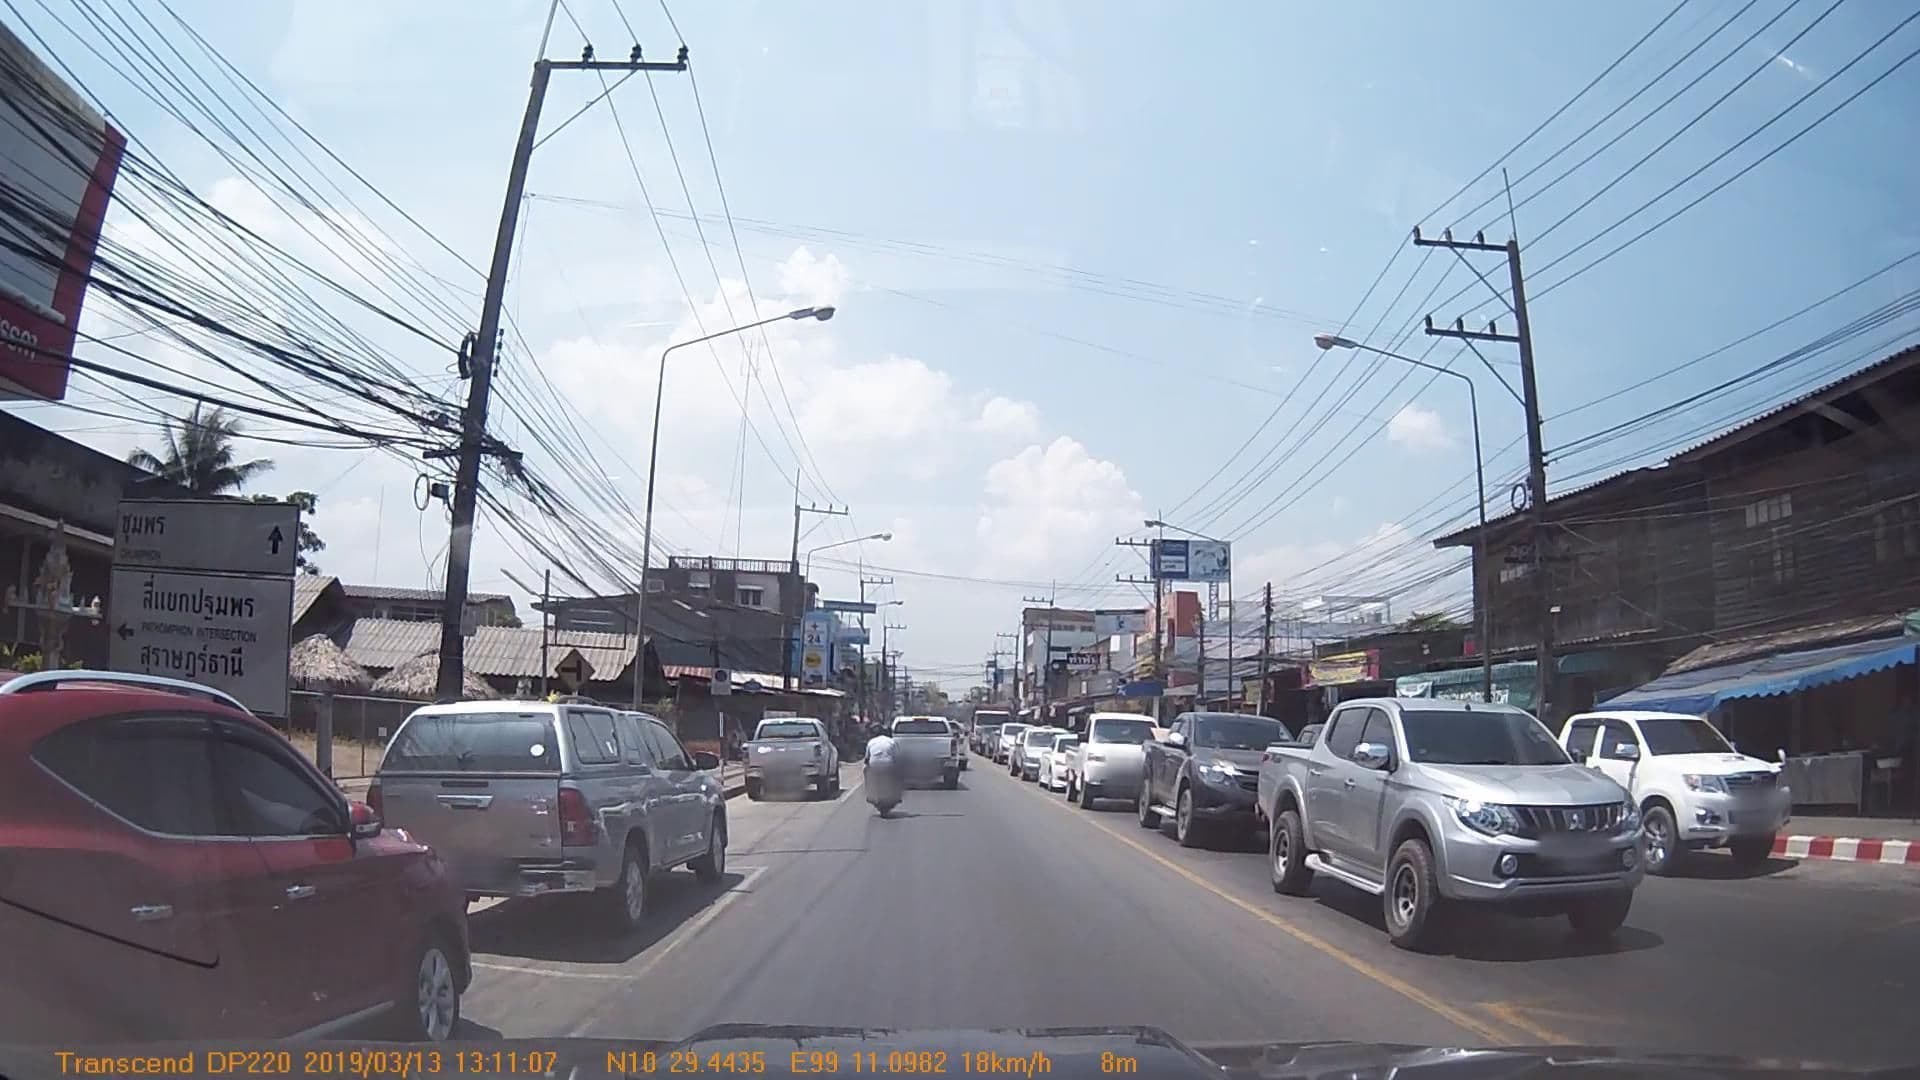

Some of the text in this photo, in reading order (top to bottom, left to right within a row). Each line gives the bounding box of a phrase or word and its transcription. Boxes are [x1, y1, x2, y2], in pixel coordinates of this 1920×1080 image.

[122, 514, 166, 544] ชุมพร
[143, 573, 254, 620] สี่แยกปฐมพร
[196, 627, 257, 643] INTERSECTION
[141, 645, 243, 677] สุราษฎร์ธานี
